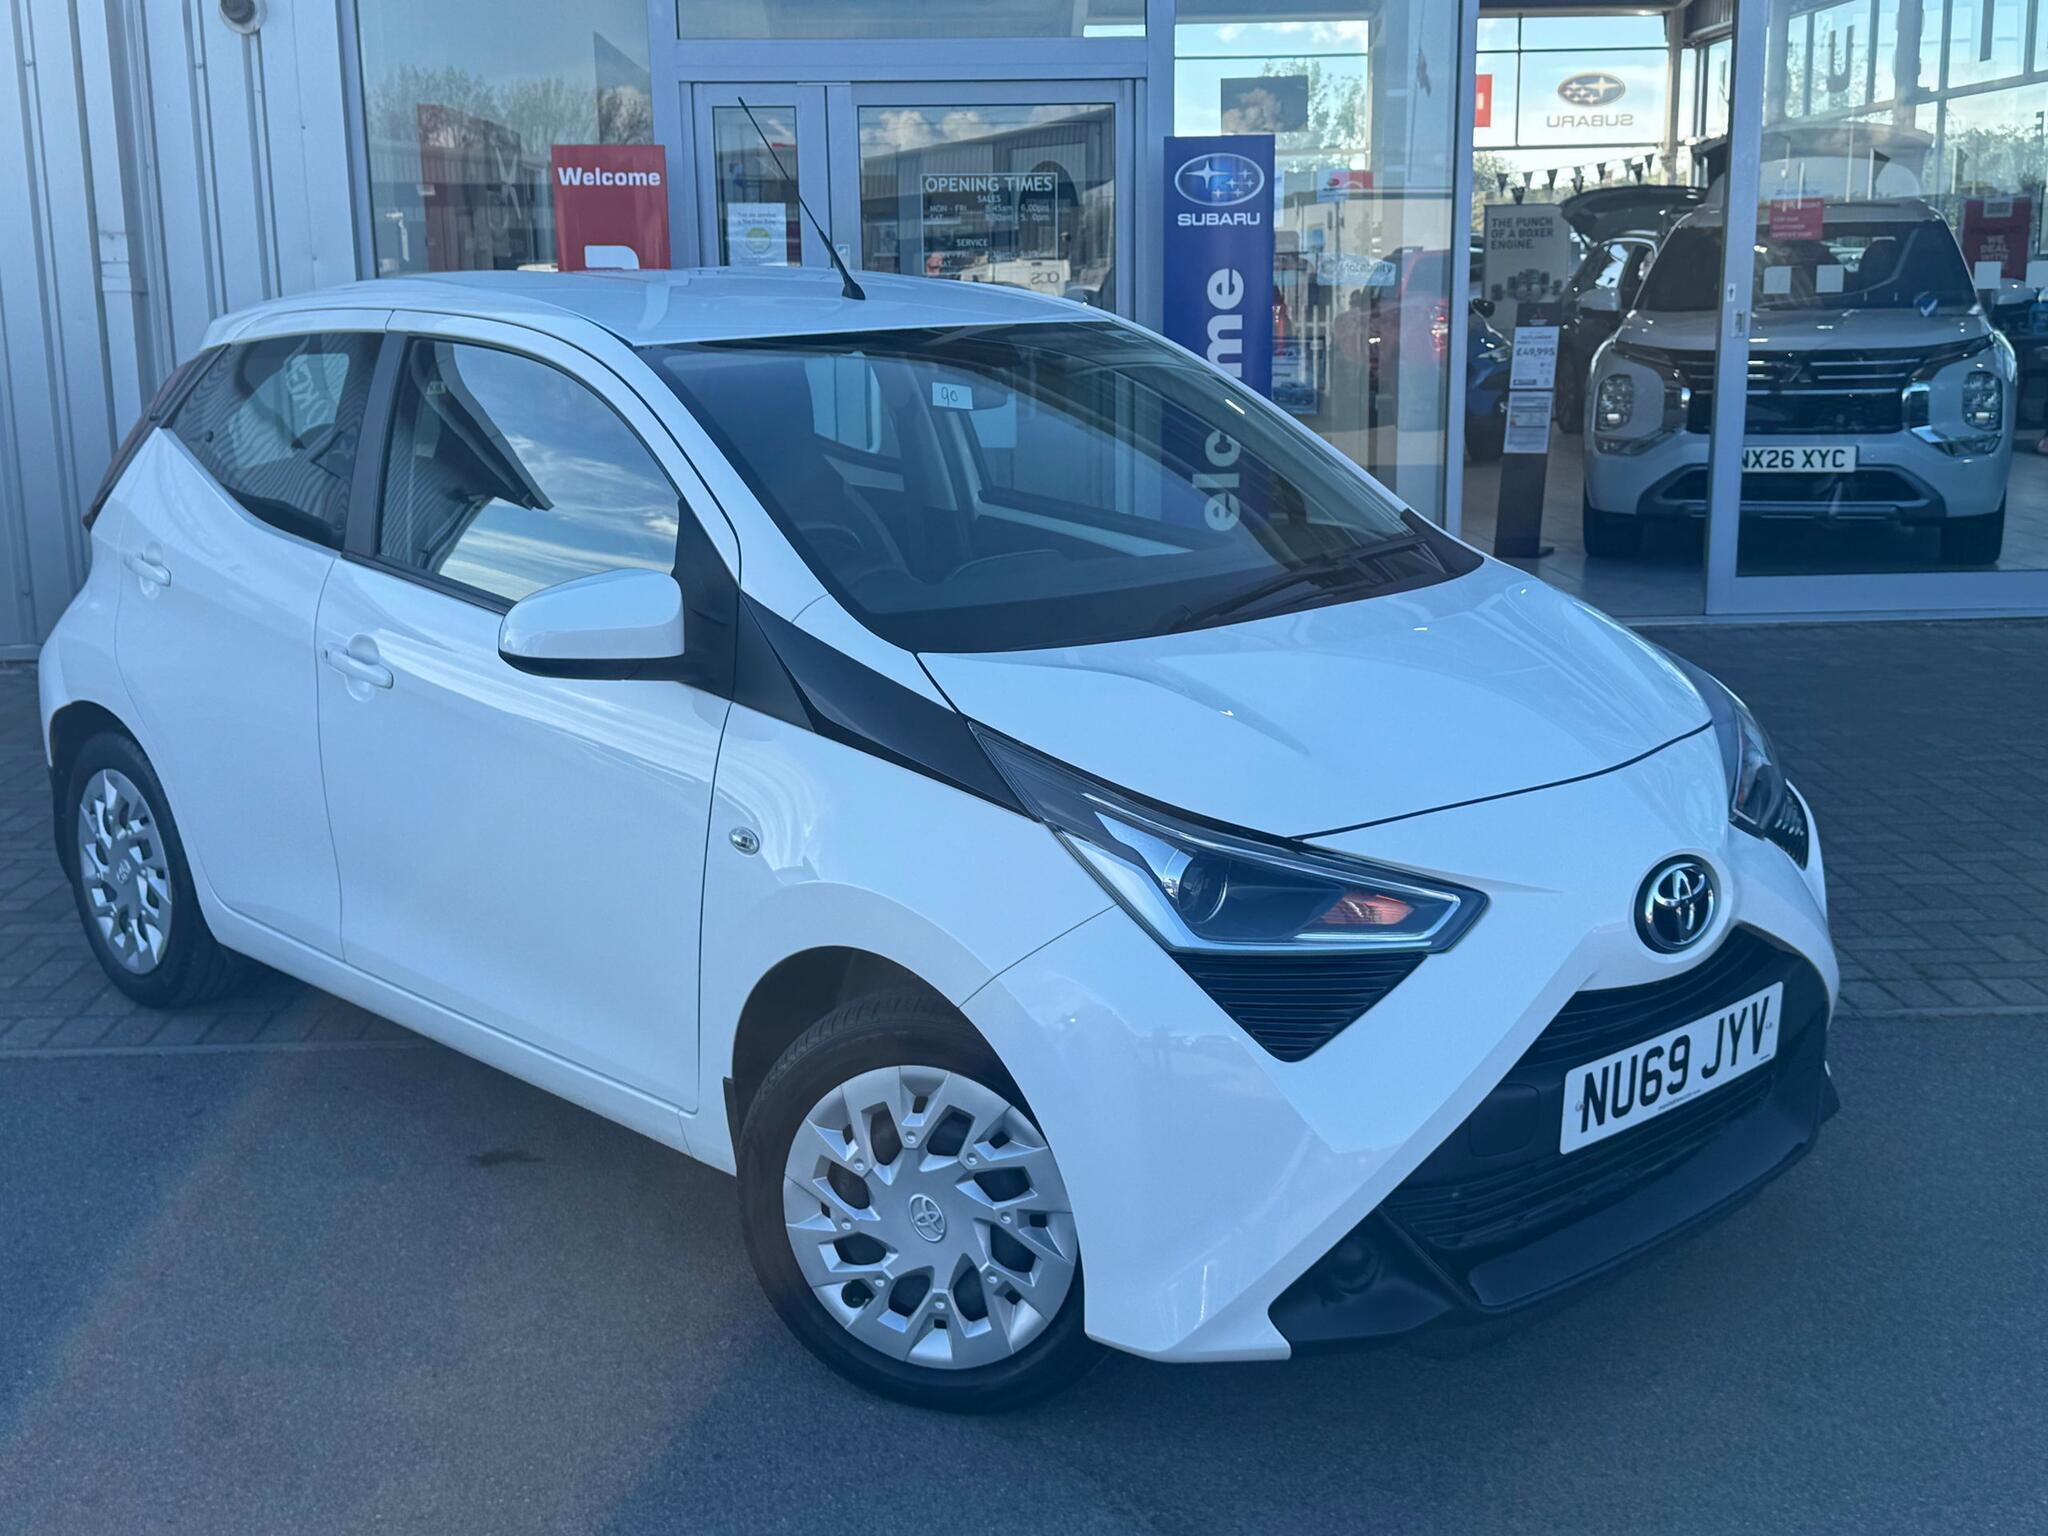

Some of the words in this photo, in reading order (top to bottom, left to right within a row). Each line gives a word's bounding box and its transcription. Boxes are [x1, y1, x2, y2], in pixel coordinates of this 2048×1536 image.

[558, 167, 661, 186] Welcome
[925, 177, 1000, 192] OPENING
[1004, 176, 1053, 192] TIMES
[977, 195, 1001, 203] SALES
[1177, 212, 1260, 226] SUBARU
[1492, 218, 1513, 227] THE
[1516, 216, 1553, 226] PUNCH
[1491, 229, 1504, 238] OF
[1508, 229, 1515, 237] A
[1518, 228, 1553, 238] BOXER
[956, 238, 988, 247] SERVICE
[1516, 347, 1555, 357] £49,995
[1801, 449, 1846, 468] XYC
[1581, 1034, 1691, 1133] NU69
[1701, 996, 1770, 1080] JYV
